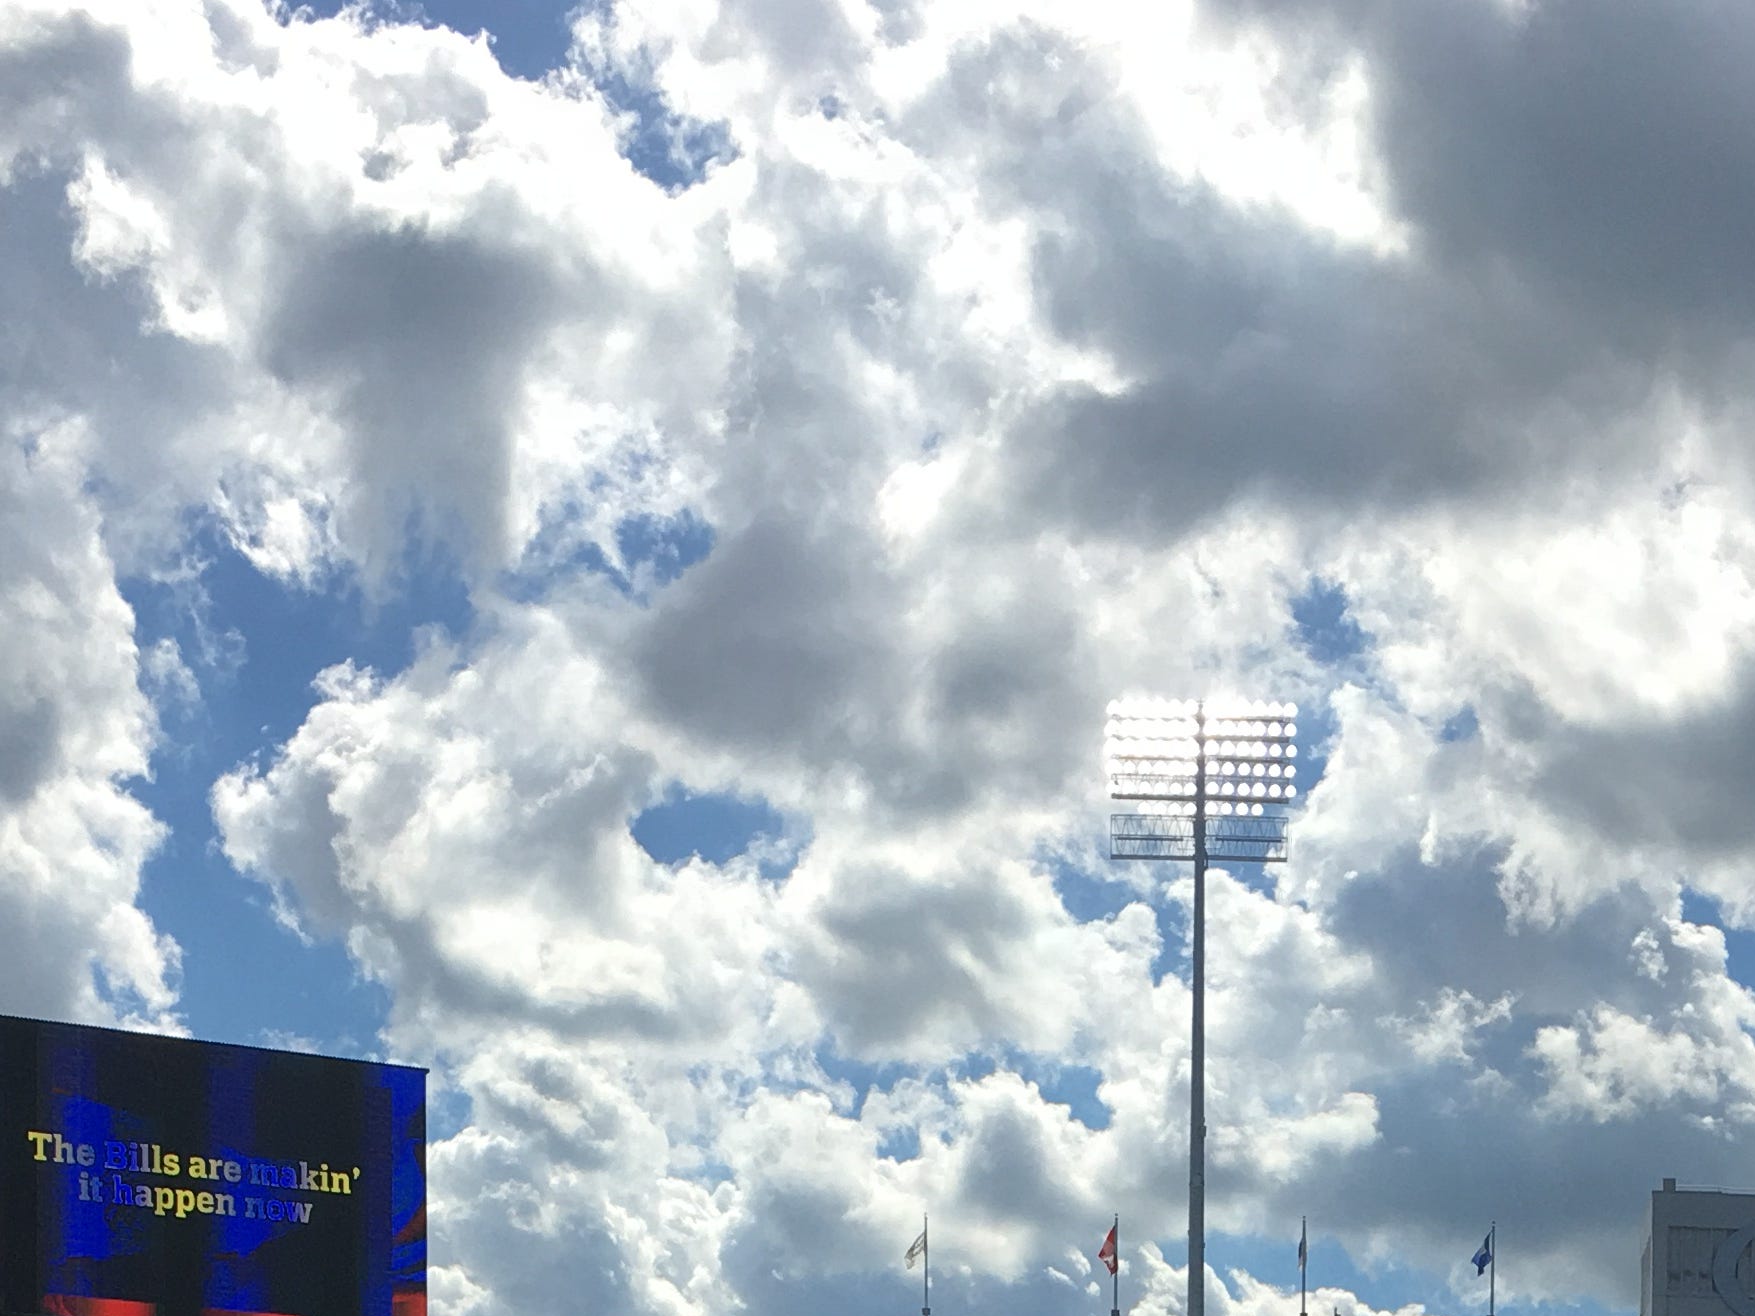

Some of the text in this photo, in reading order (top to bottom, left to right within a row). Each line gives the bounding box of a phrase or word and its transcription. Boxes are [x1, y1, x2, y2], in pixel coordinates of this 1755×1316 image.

[27, 1130, 361, 1195] The Bills are makin'
[78, 1171, 313, 1225] it happen now
